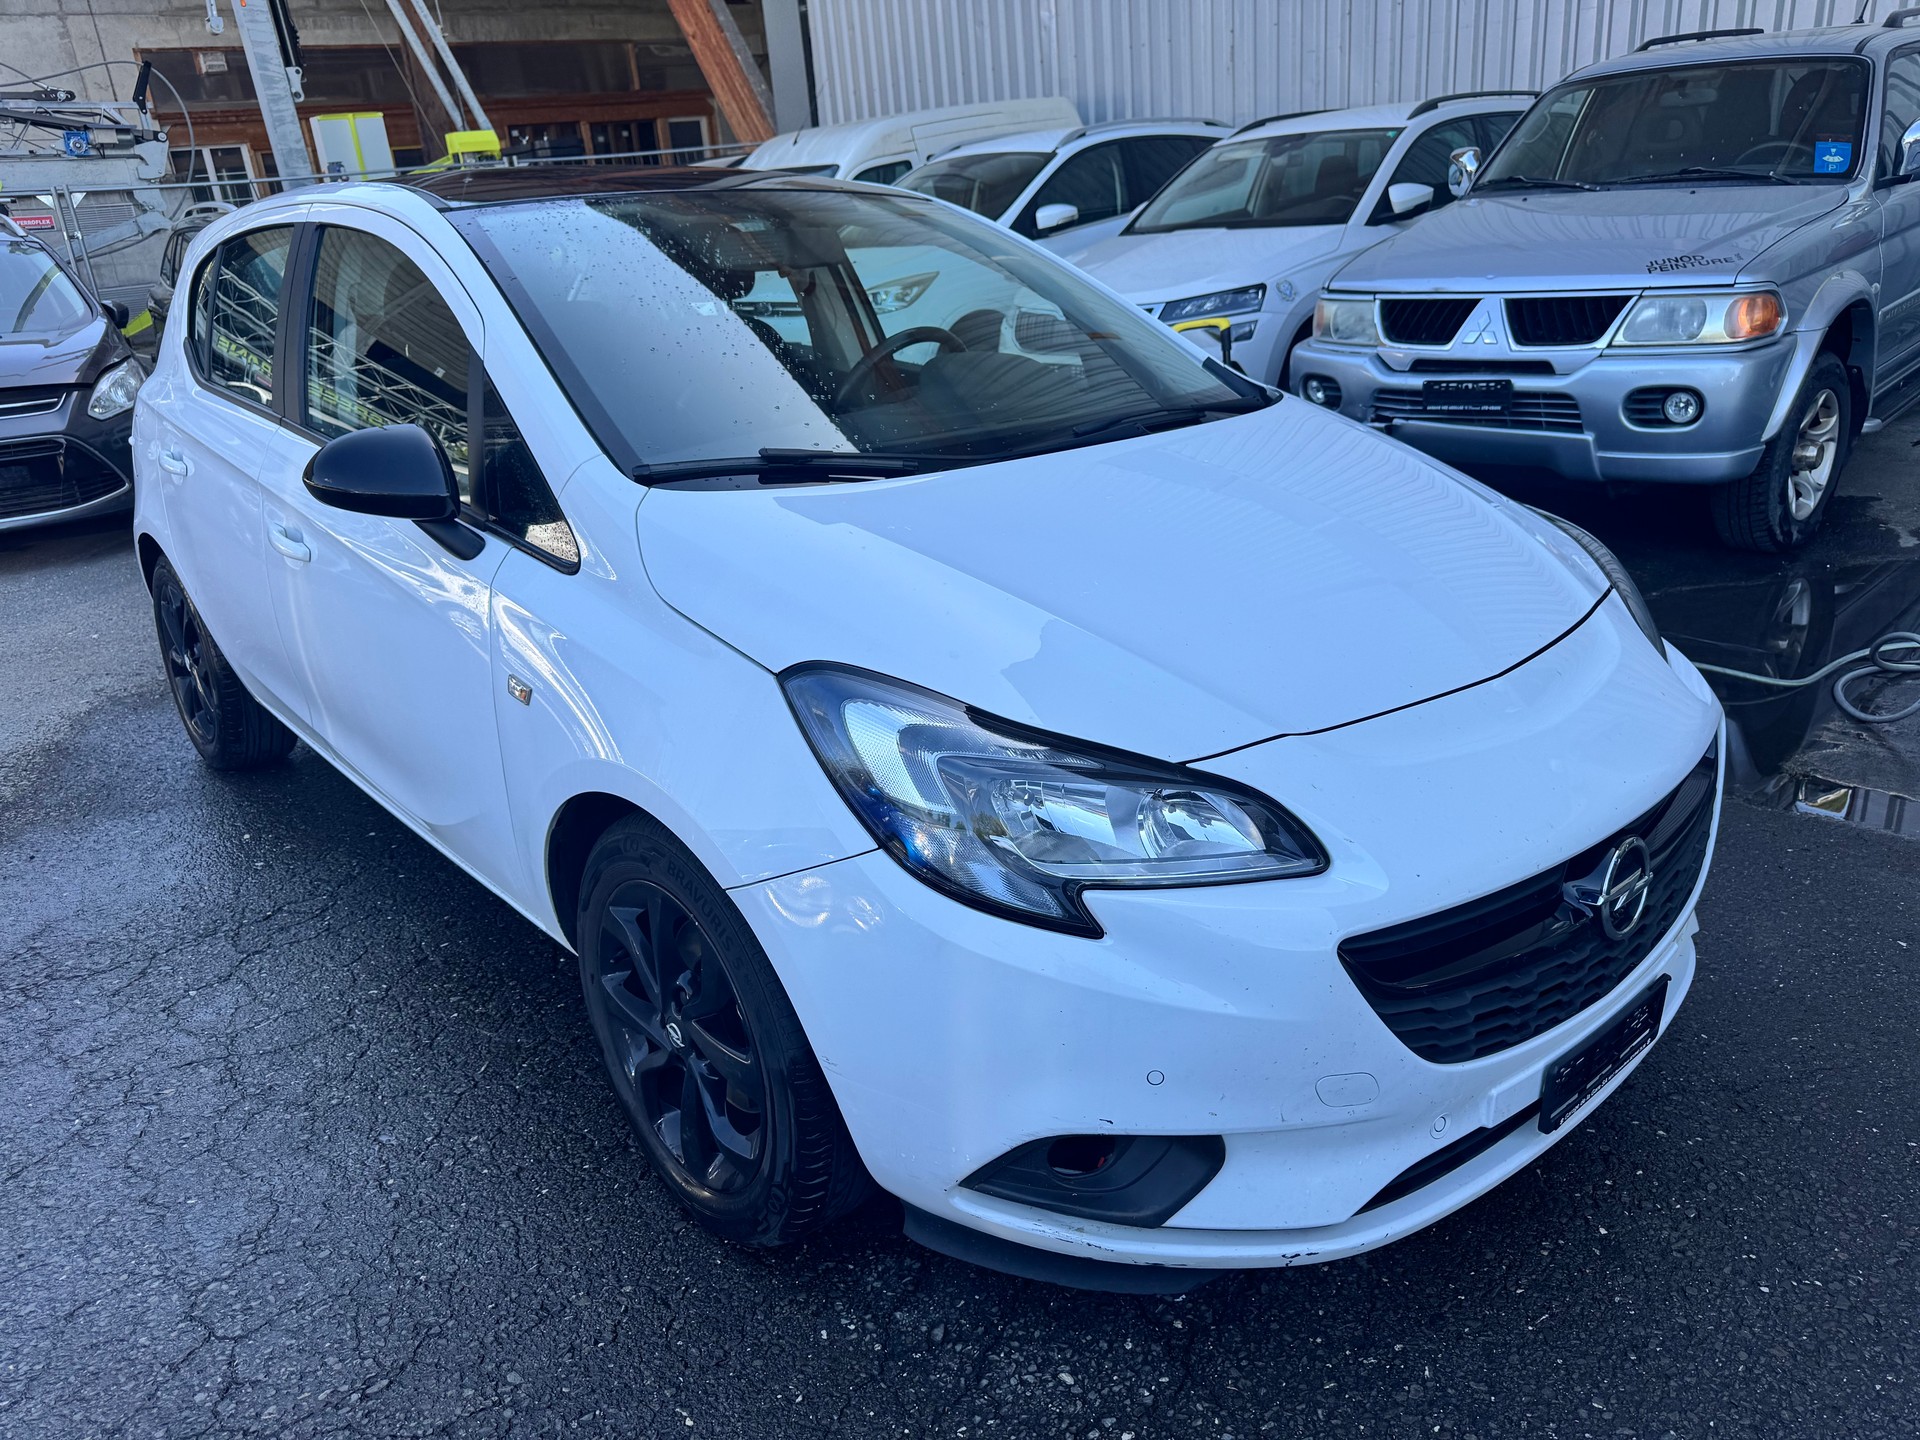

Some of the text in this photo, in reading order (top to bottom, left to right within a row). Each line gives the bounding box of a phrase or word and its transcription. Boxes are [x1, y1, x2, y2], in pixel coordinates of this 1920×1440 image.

[1645, 254, 1705, 268] JUNOD
[1646, 256, 1735, 274] PEINTURE
[666, 860, 734, 952] BRAVURIS
